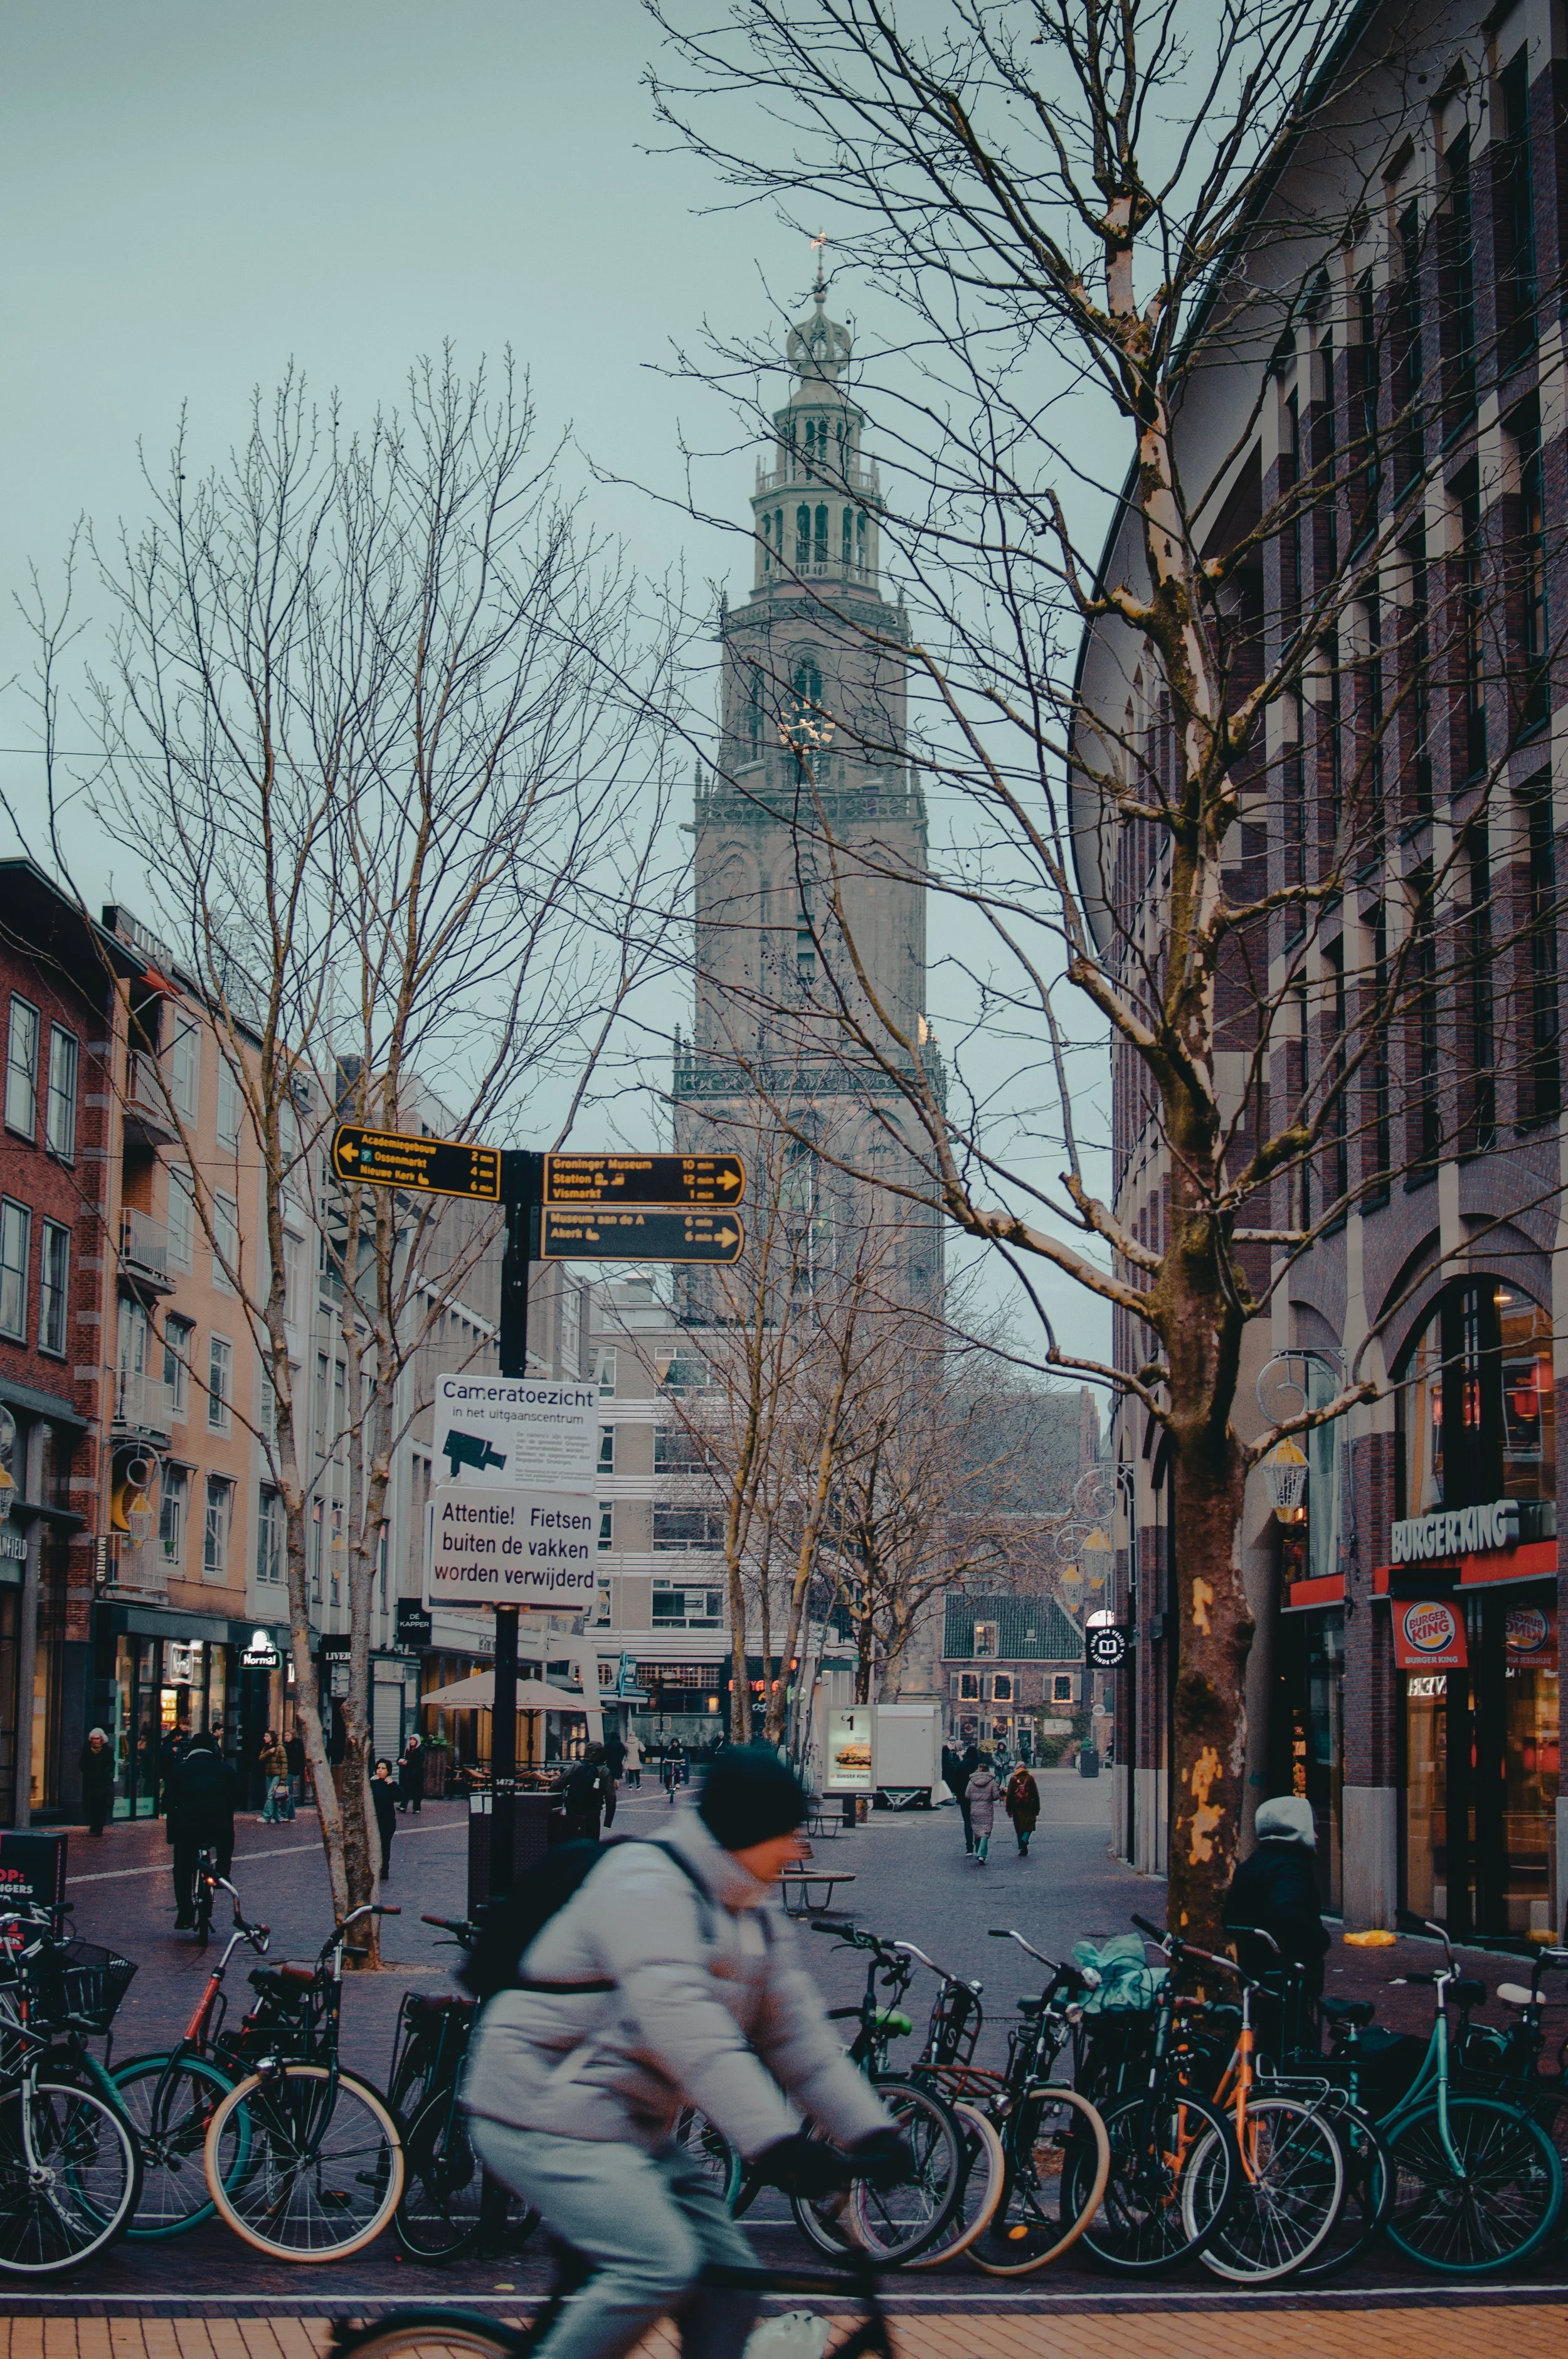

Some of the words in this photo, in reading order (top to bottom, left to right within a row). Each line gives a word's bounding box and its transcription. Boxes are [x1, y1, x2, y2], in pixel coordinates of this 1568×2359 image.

[361, 1134, 437, 1154] Academiegebouw
[471, 1151, 479, 1162] 2
[479, 1154, 494, 1164] min
[374, 1151, 428, 1169] Ossenmarkt
[470, 1166, 478, 1176] 4
[479, 1169, 494, 1178] min
[553, 1158, 605, 1171] Groninger
[608, 1159, 653, 1169] Museum
[682, 1159, 695, 1170] 10
[697, 1161, 714, 1170] min
[360, 1164, 393, 1179] Nieuwe
[395, 1169, 415, 1181] Kerk
[470, 1181, 477, 1191] 6
[479, 1184, 494, 1193] min
[553, 1173, 592, 1185] Station
[682, 1174, 695, 1185] 12
[696, 1176, 714, 1185] min
[553, 1188, 602, 1199] Vismarkt
[689, 1190, 695, 1199] 1
[696, 1191, 714, 1200] min
[550, 1212, 595, 1223] Museum
[596, 1215, 618, 1225] aan
[619, 1214, 633, 1225] de
[635, 1214, 645, 1225] A
[684, 1216, 694, 1227] 6
[694, 1218, 714, 1227] min
[550, 1227, 583, 1239] Akerk
[684, 1231, 694, 1242] 6
[694, 1232, 713, 1242] min
[443, 1381, 594, 1407] Cameratoezicht
[452, 1406, 462, 1417] in
[467, 1407, 485, 1419] het
[489, 1408, 584, 1425] uitgaanscentrum
[442, 1502, 514, 1525] Attentie!
[530, 1508, 591, 1530] Fietsen
[1391, 1511, 1459, 1563] BURGER
[1459, 1499, 1510, 1553] KING
[0, 1535, 27, 1560] NFIELD
[443, 1531, 495, 1553] buiten
[502, 1535, 522, 1555] de
[529, 1538, 588, 1559] vakken
[96, 1536, 107, 1582] MANFIELD
[435, 1563, 498, 1583] worden
[505, 1567, 595, 1590] verwijderd
[1409, 1610, 1448, 1631] BURGER
[1412, 1619, 1450, 1644] KING
[1090, 1634, 1099, 1647] VAN
[1111, 1629, 1125, 1647] VELDE
[243, 1653, 276, 1665] Normal
[1092, 1654, 1110, 1664] SINDS
